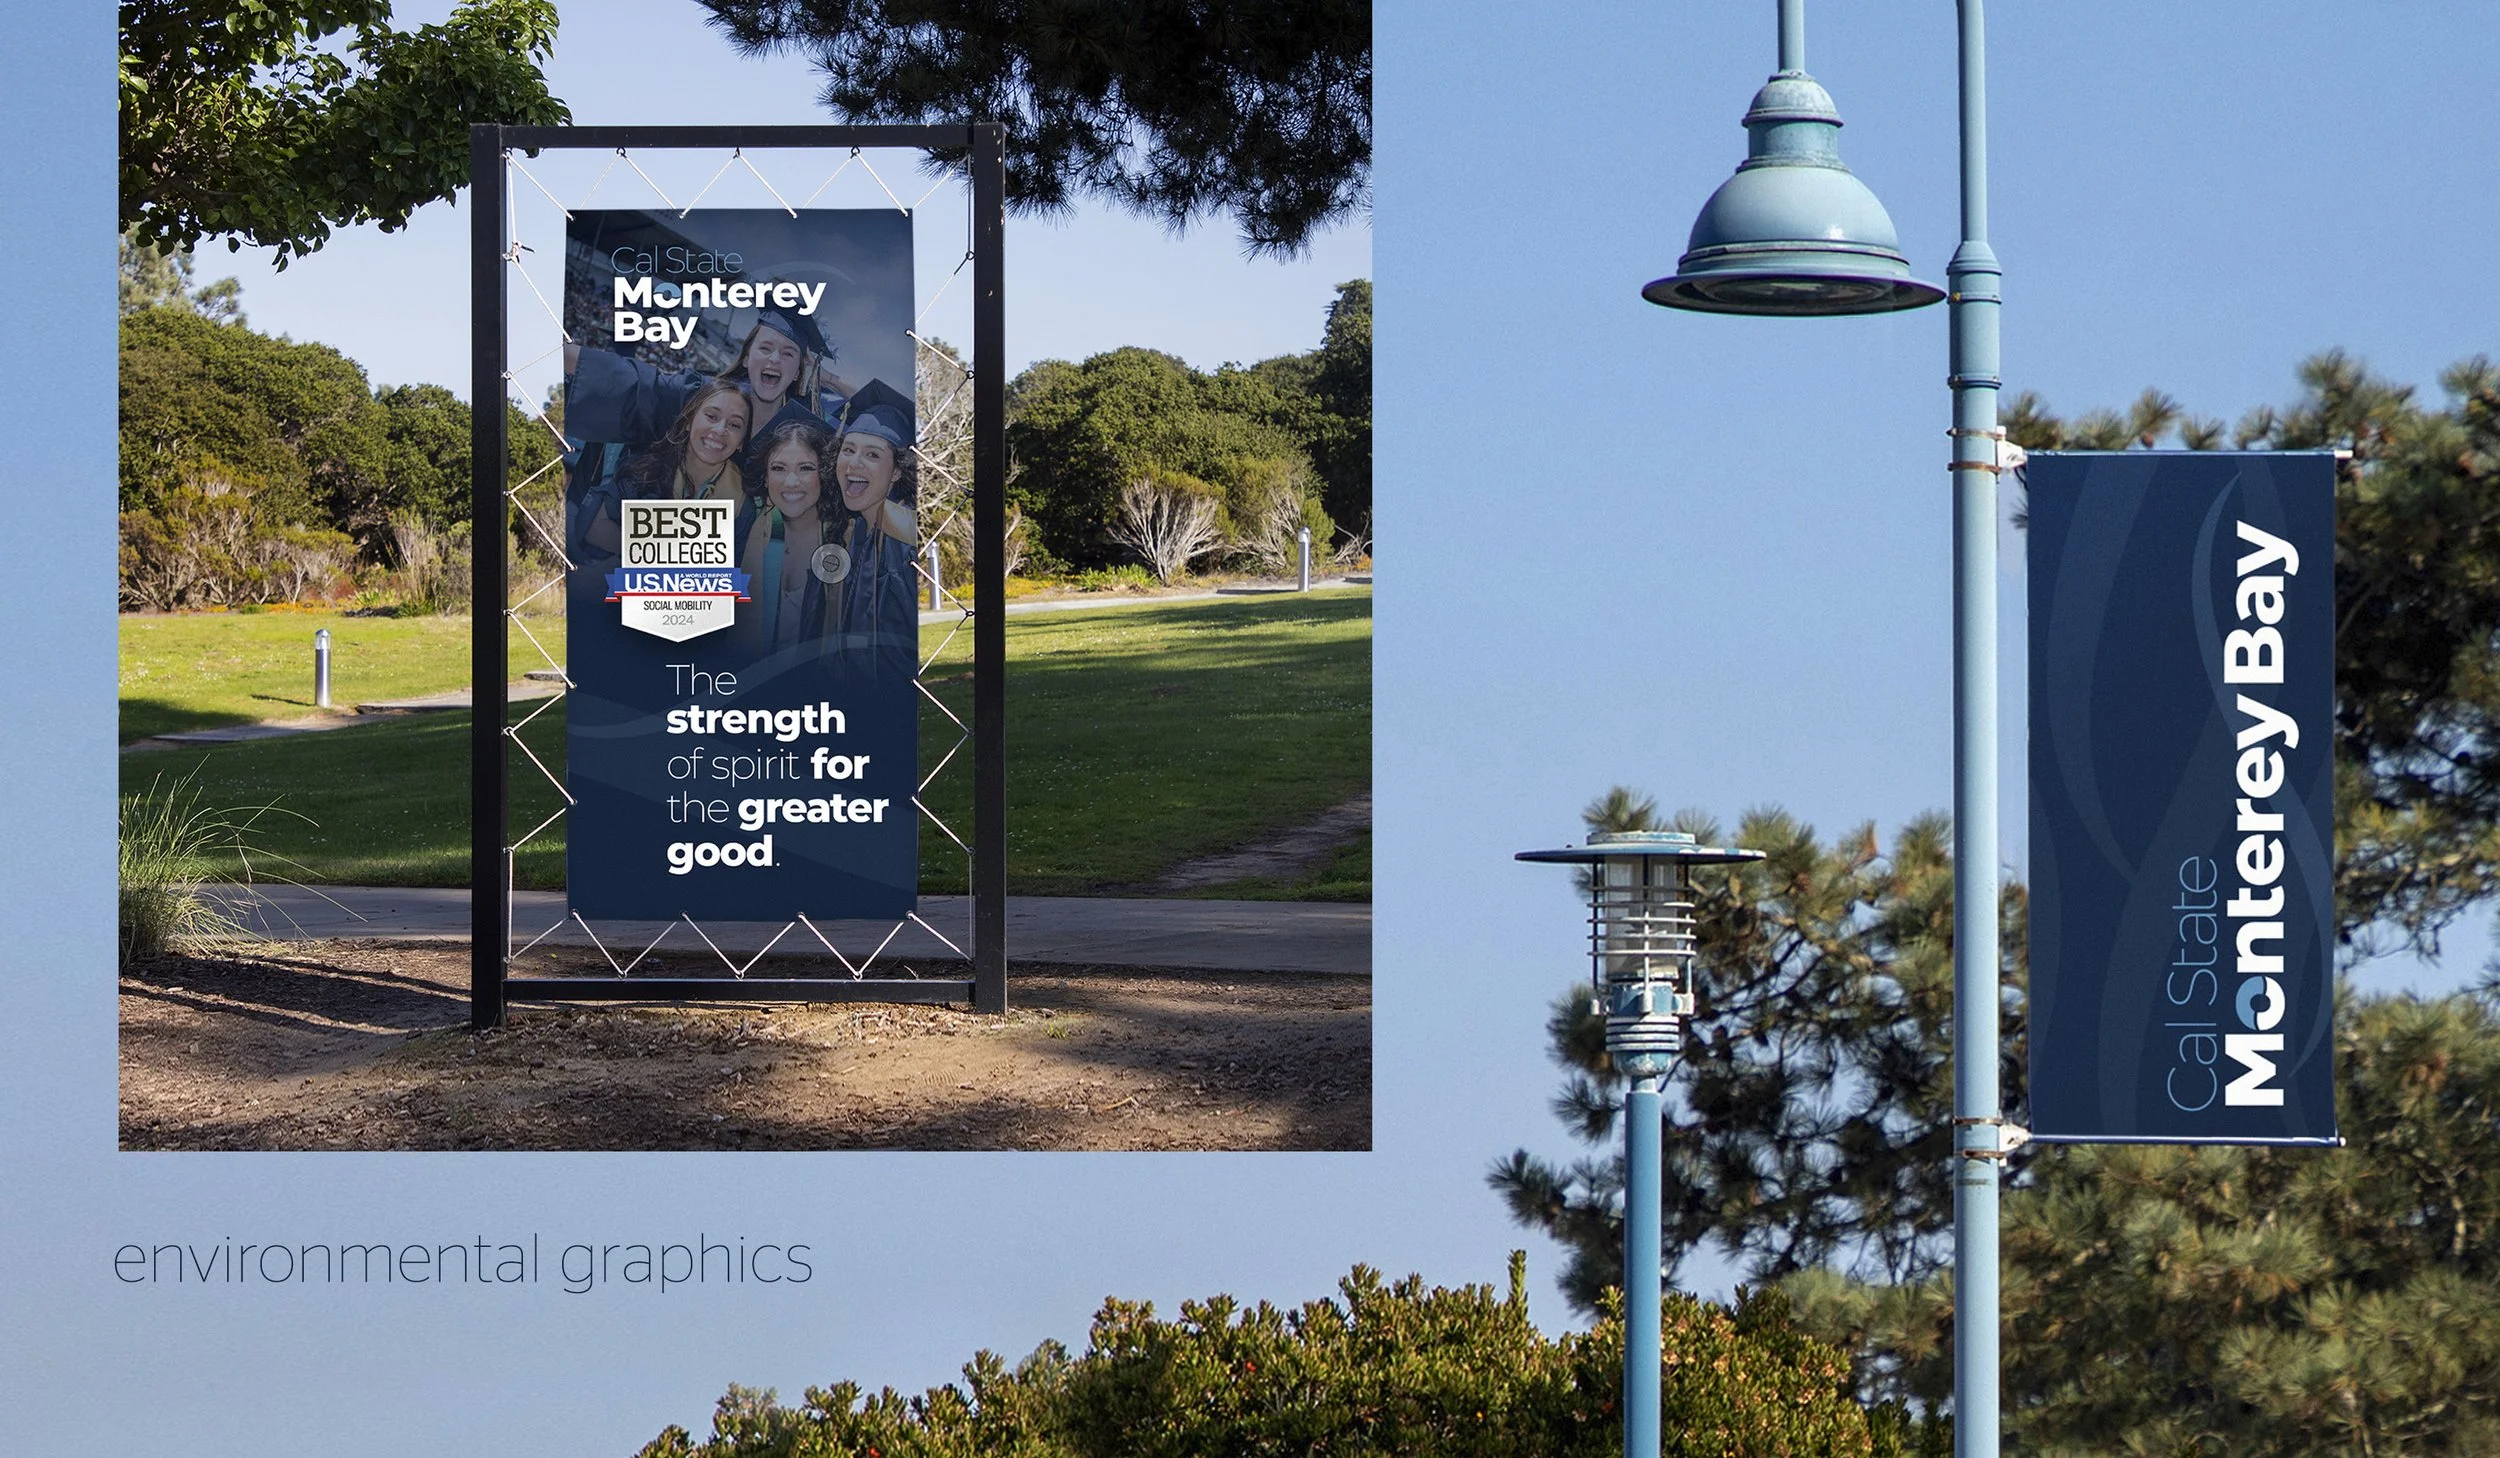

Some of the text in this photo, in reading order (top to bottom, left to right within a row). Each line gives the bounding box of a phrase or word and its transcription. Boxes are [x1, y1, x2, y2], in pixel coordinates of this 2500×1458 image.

[611, 246, 744, 274] Cal State
[614, 276, 827, 315] Monterey
[614, 311, 699, 349] Bay
[629, 507, 727, 539] BEST
[629, 541, 727, 565] COLLEGES
[643, 600, 713, 610] SOCIAL MOBILITY
[662, 614, 695, 626] 2024
[665, 663, 737, 695] The
[666, 702, 846, 742] strength
[667, 747, 870, 788] of spirit for
[666, 791, 890, 831] the greater
[2223, 520, 2300, 1107] Monterey Bay
[666, 834, 781, 876] good.
[2164, 855, 2218, 1112] Cal State
